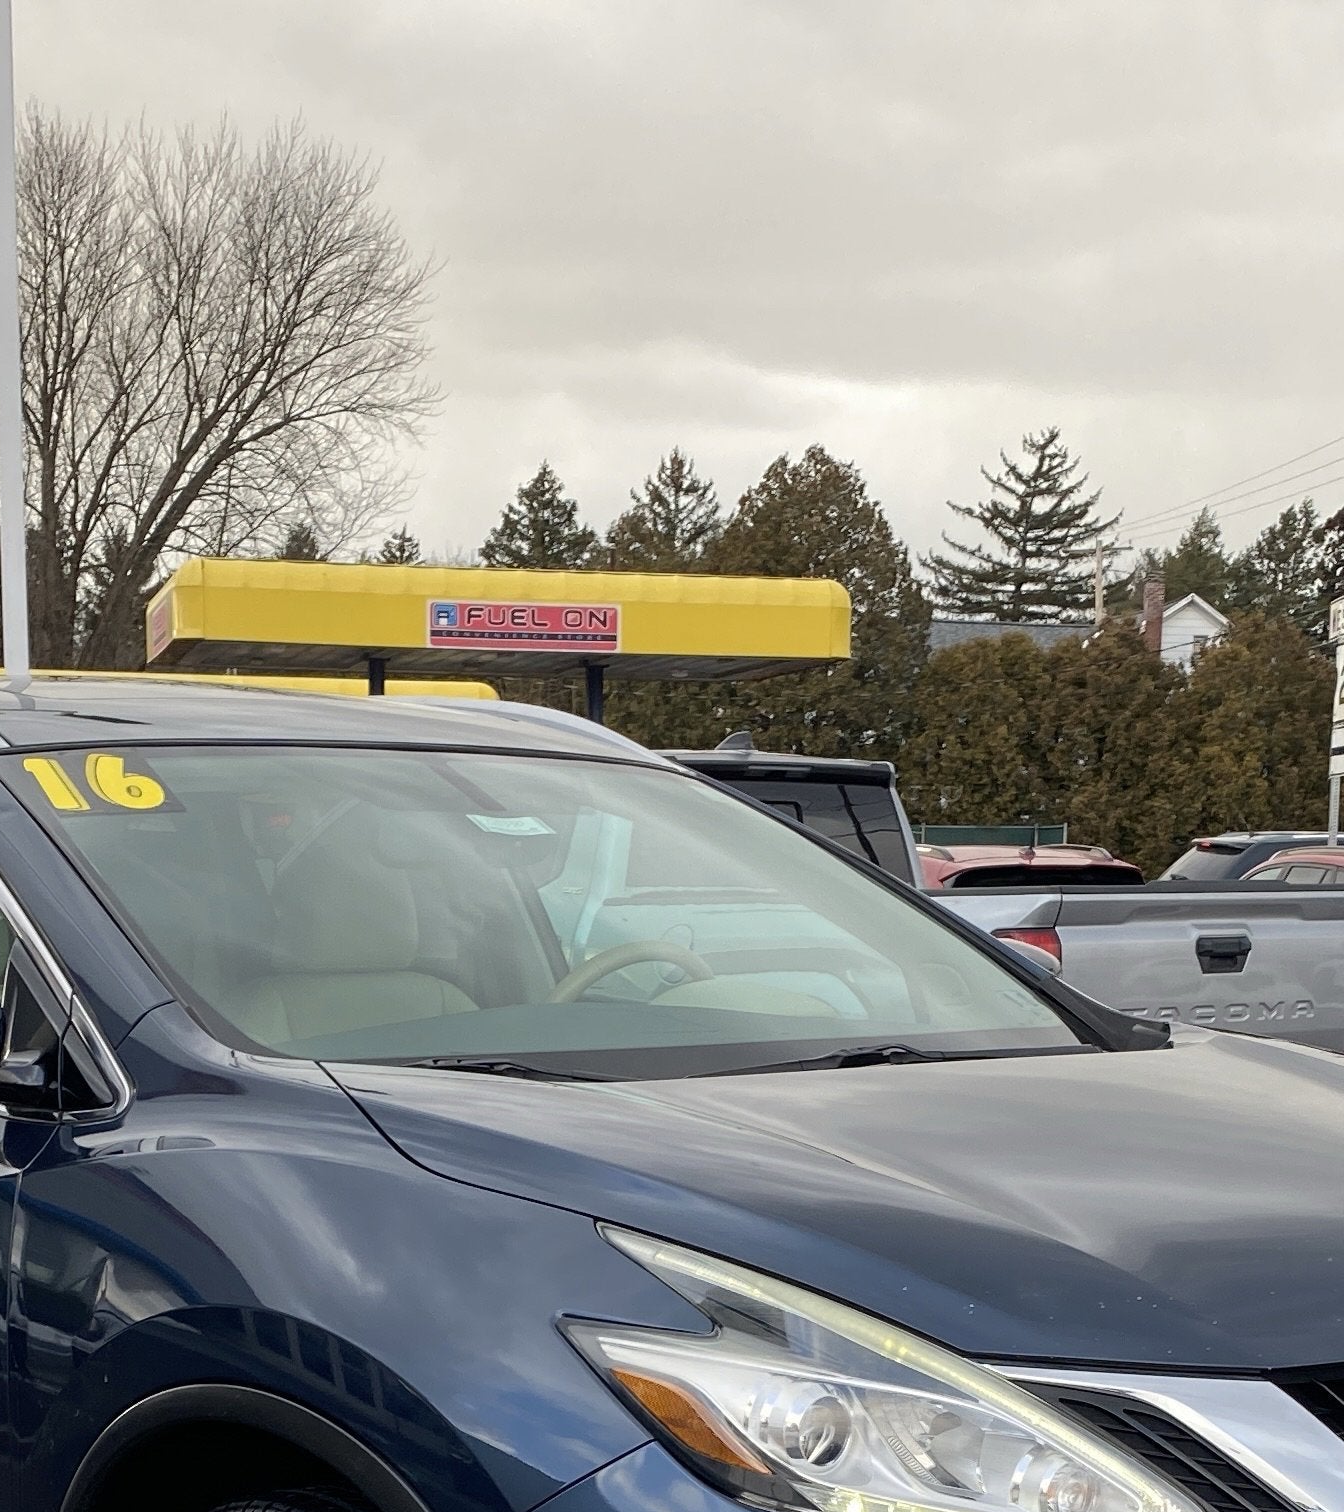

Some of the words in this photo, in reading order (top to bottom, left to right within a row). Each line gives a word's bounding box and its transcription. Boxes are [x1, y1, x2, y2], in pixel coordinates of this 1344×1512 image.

[466, 606, 549, 627] FUEL
[564, 609, 608, 629] ON
[441, 630, 548, 640] CONVENIENCE
[557, 633, 603, 642] STORE
[22, 752, 166, 810] 16
